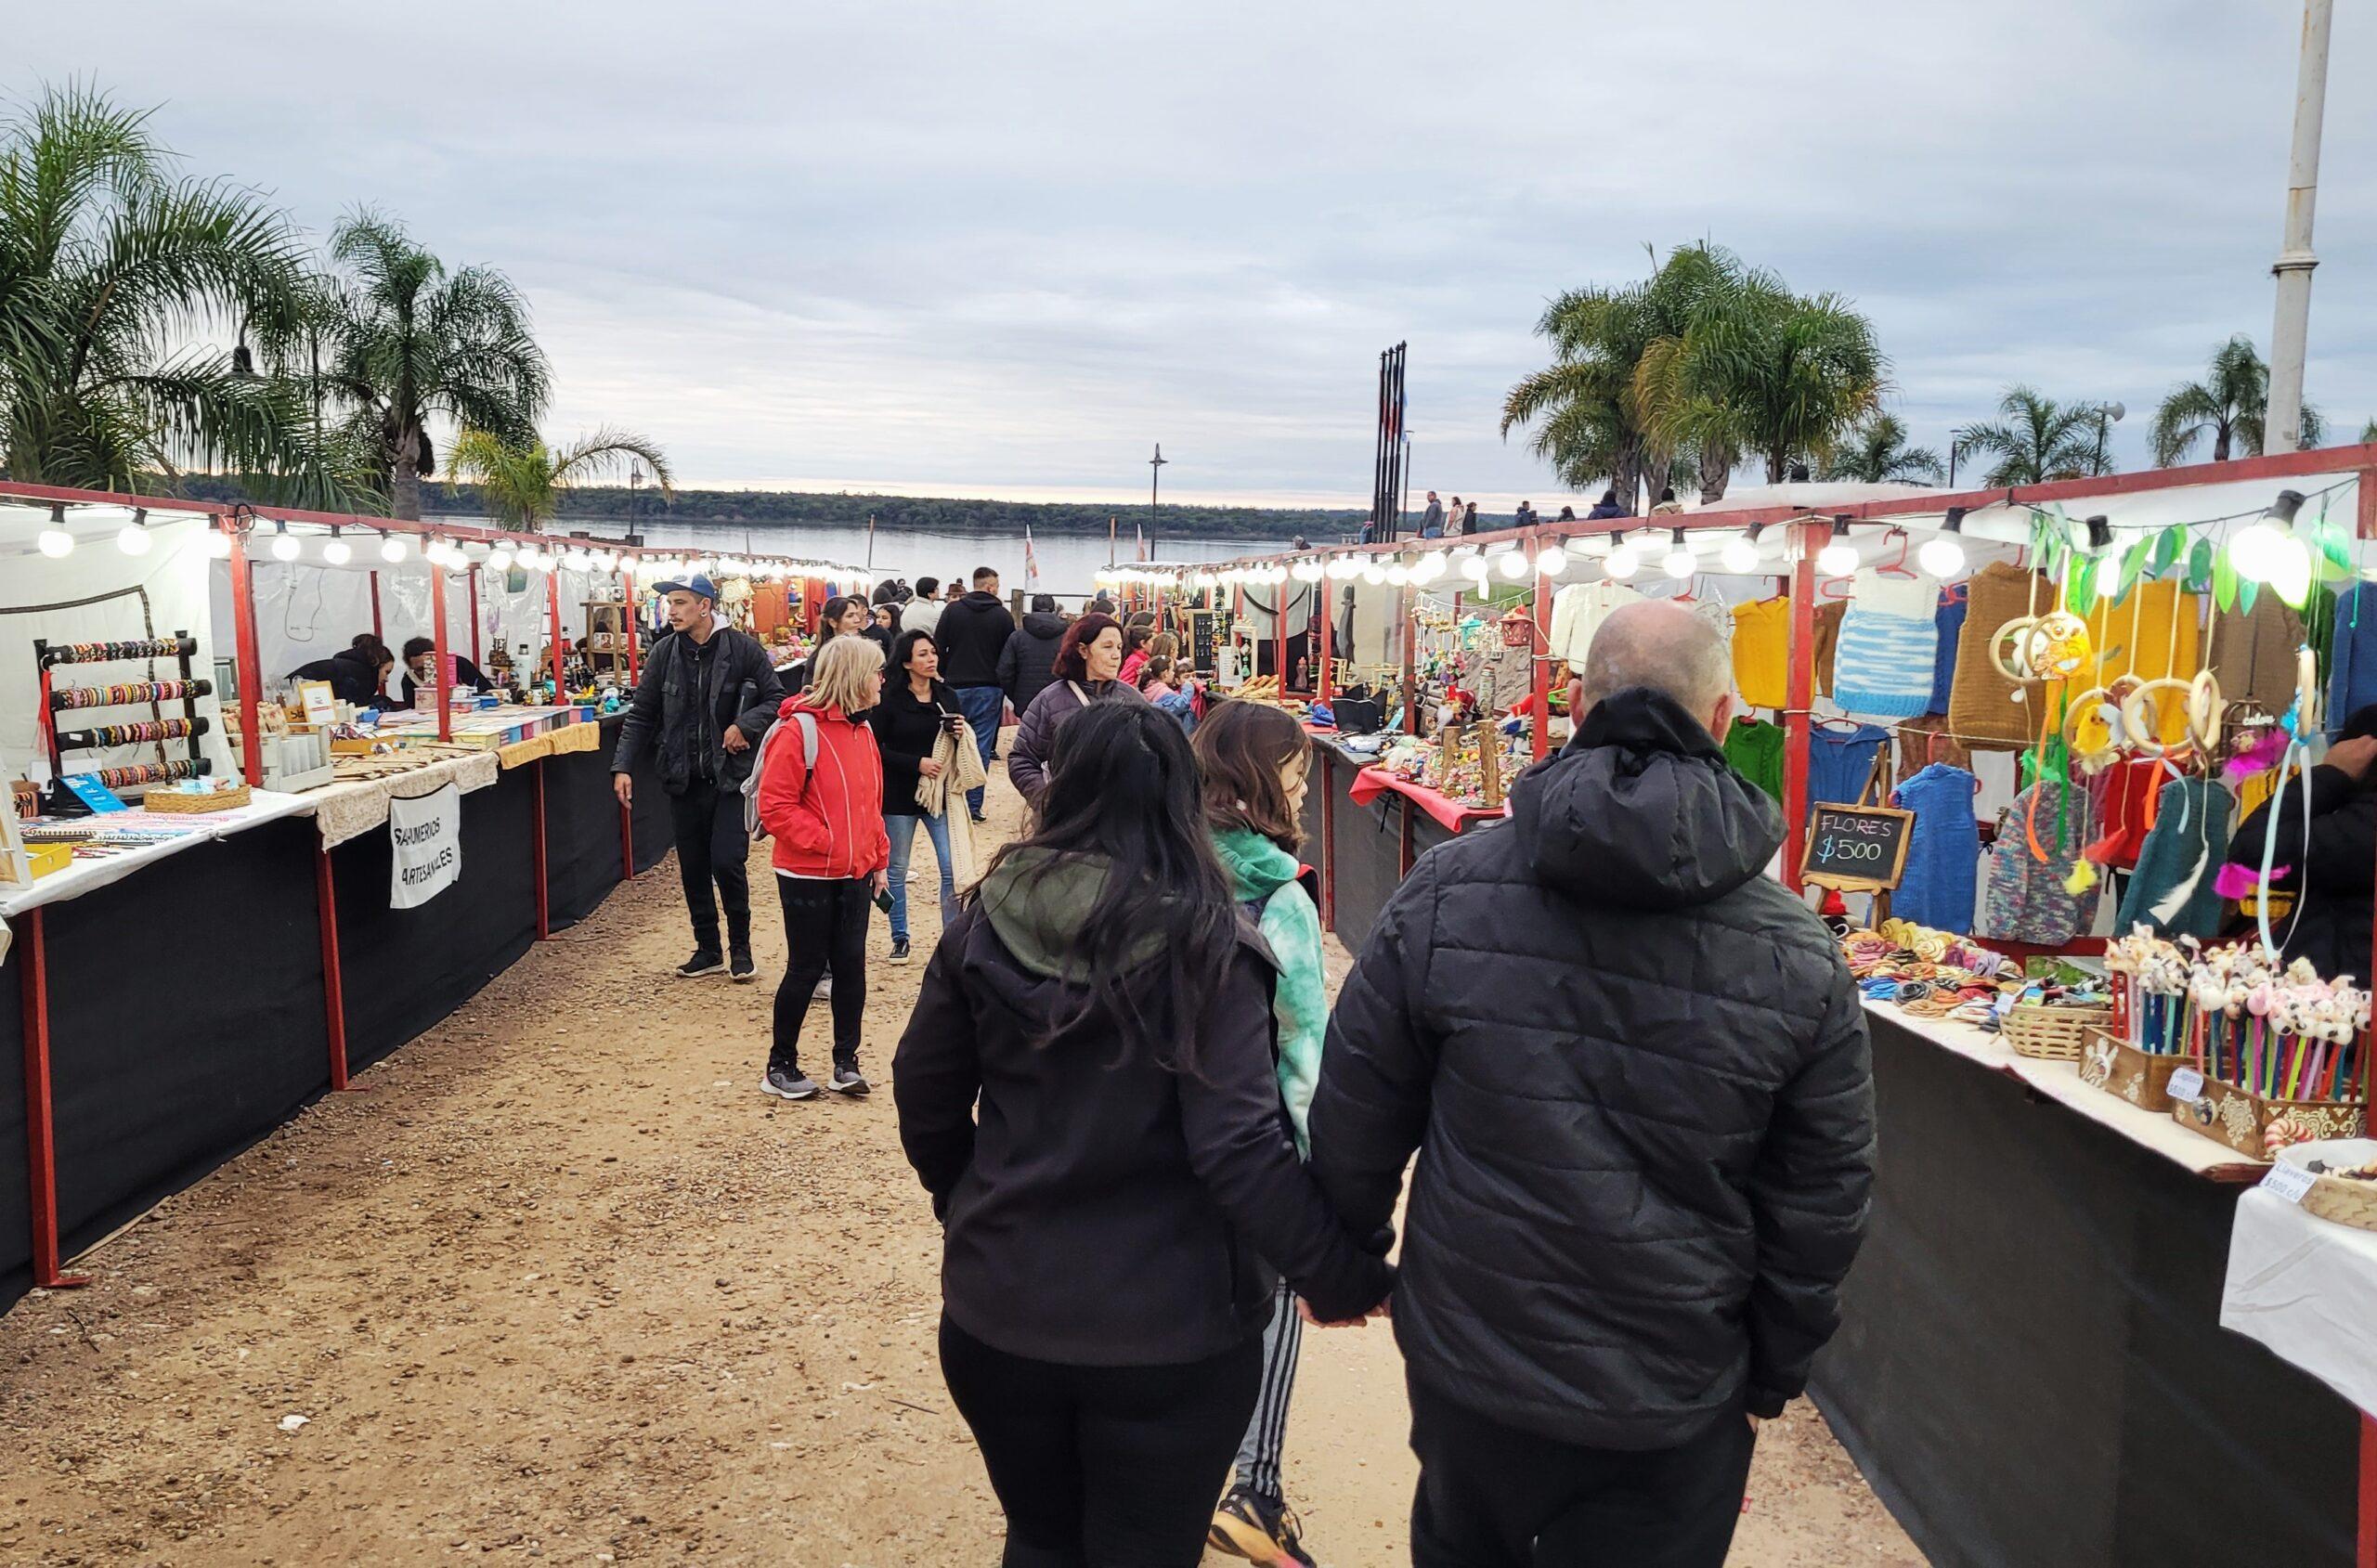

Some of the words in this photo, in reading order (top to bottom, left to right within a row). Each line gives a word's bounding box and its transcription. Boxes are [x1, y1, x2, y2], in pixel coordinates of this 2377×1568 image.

[1821, 815, 1892, 837] FLORES
[1816, 835, 1882, 864] $500
[2265, 1176, 2289, 1194] $500
